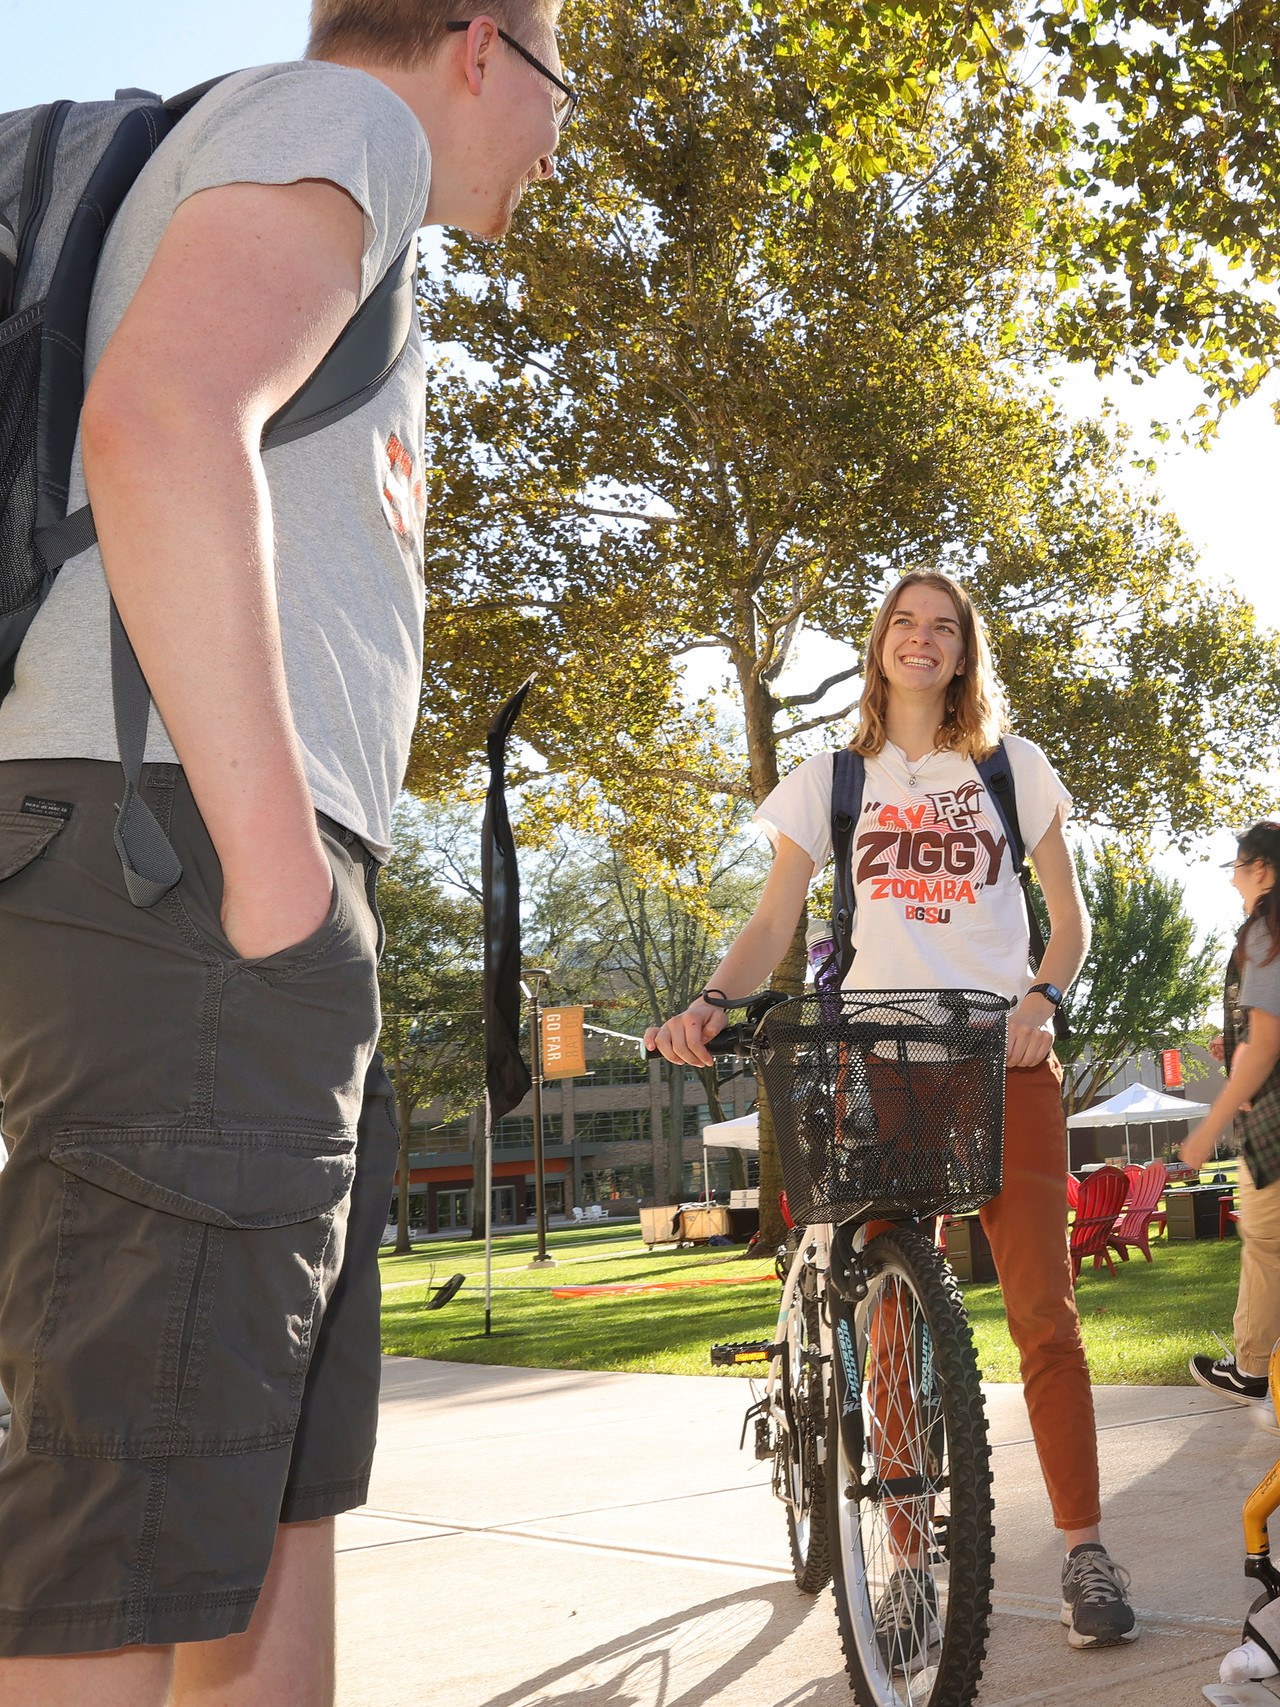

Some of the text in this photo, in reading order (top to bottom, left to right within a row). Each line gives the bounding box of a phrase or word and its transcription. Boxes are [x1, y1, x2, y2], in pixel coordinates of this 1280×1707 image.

[857, 830, 1006, 886] ZIGGY
[905, 905, 951, 924] BGSU
[546, 1013, 562, 1066] GO FAR.
